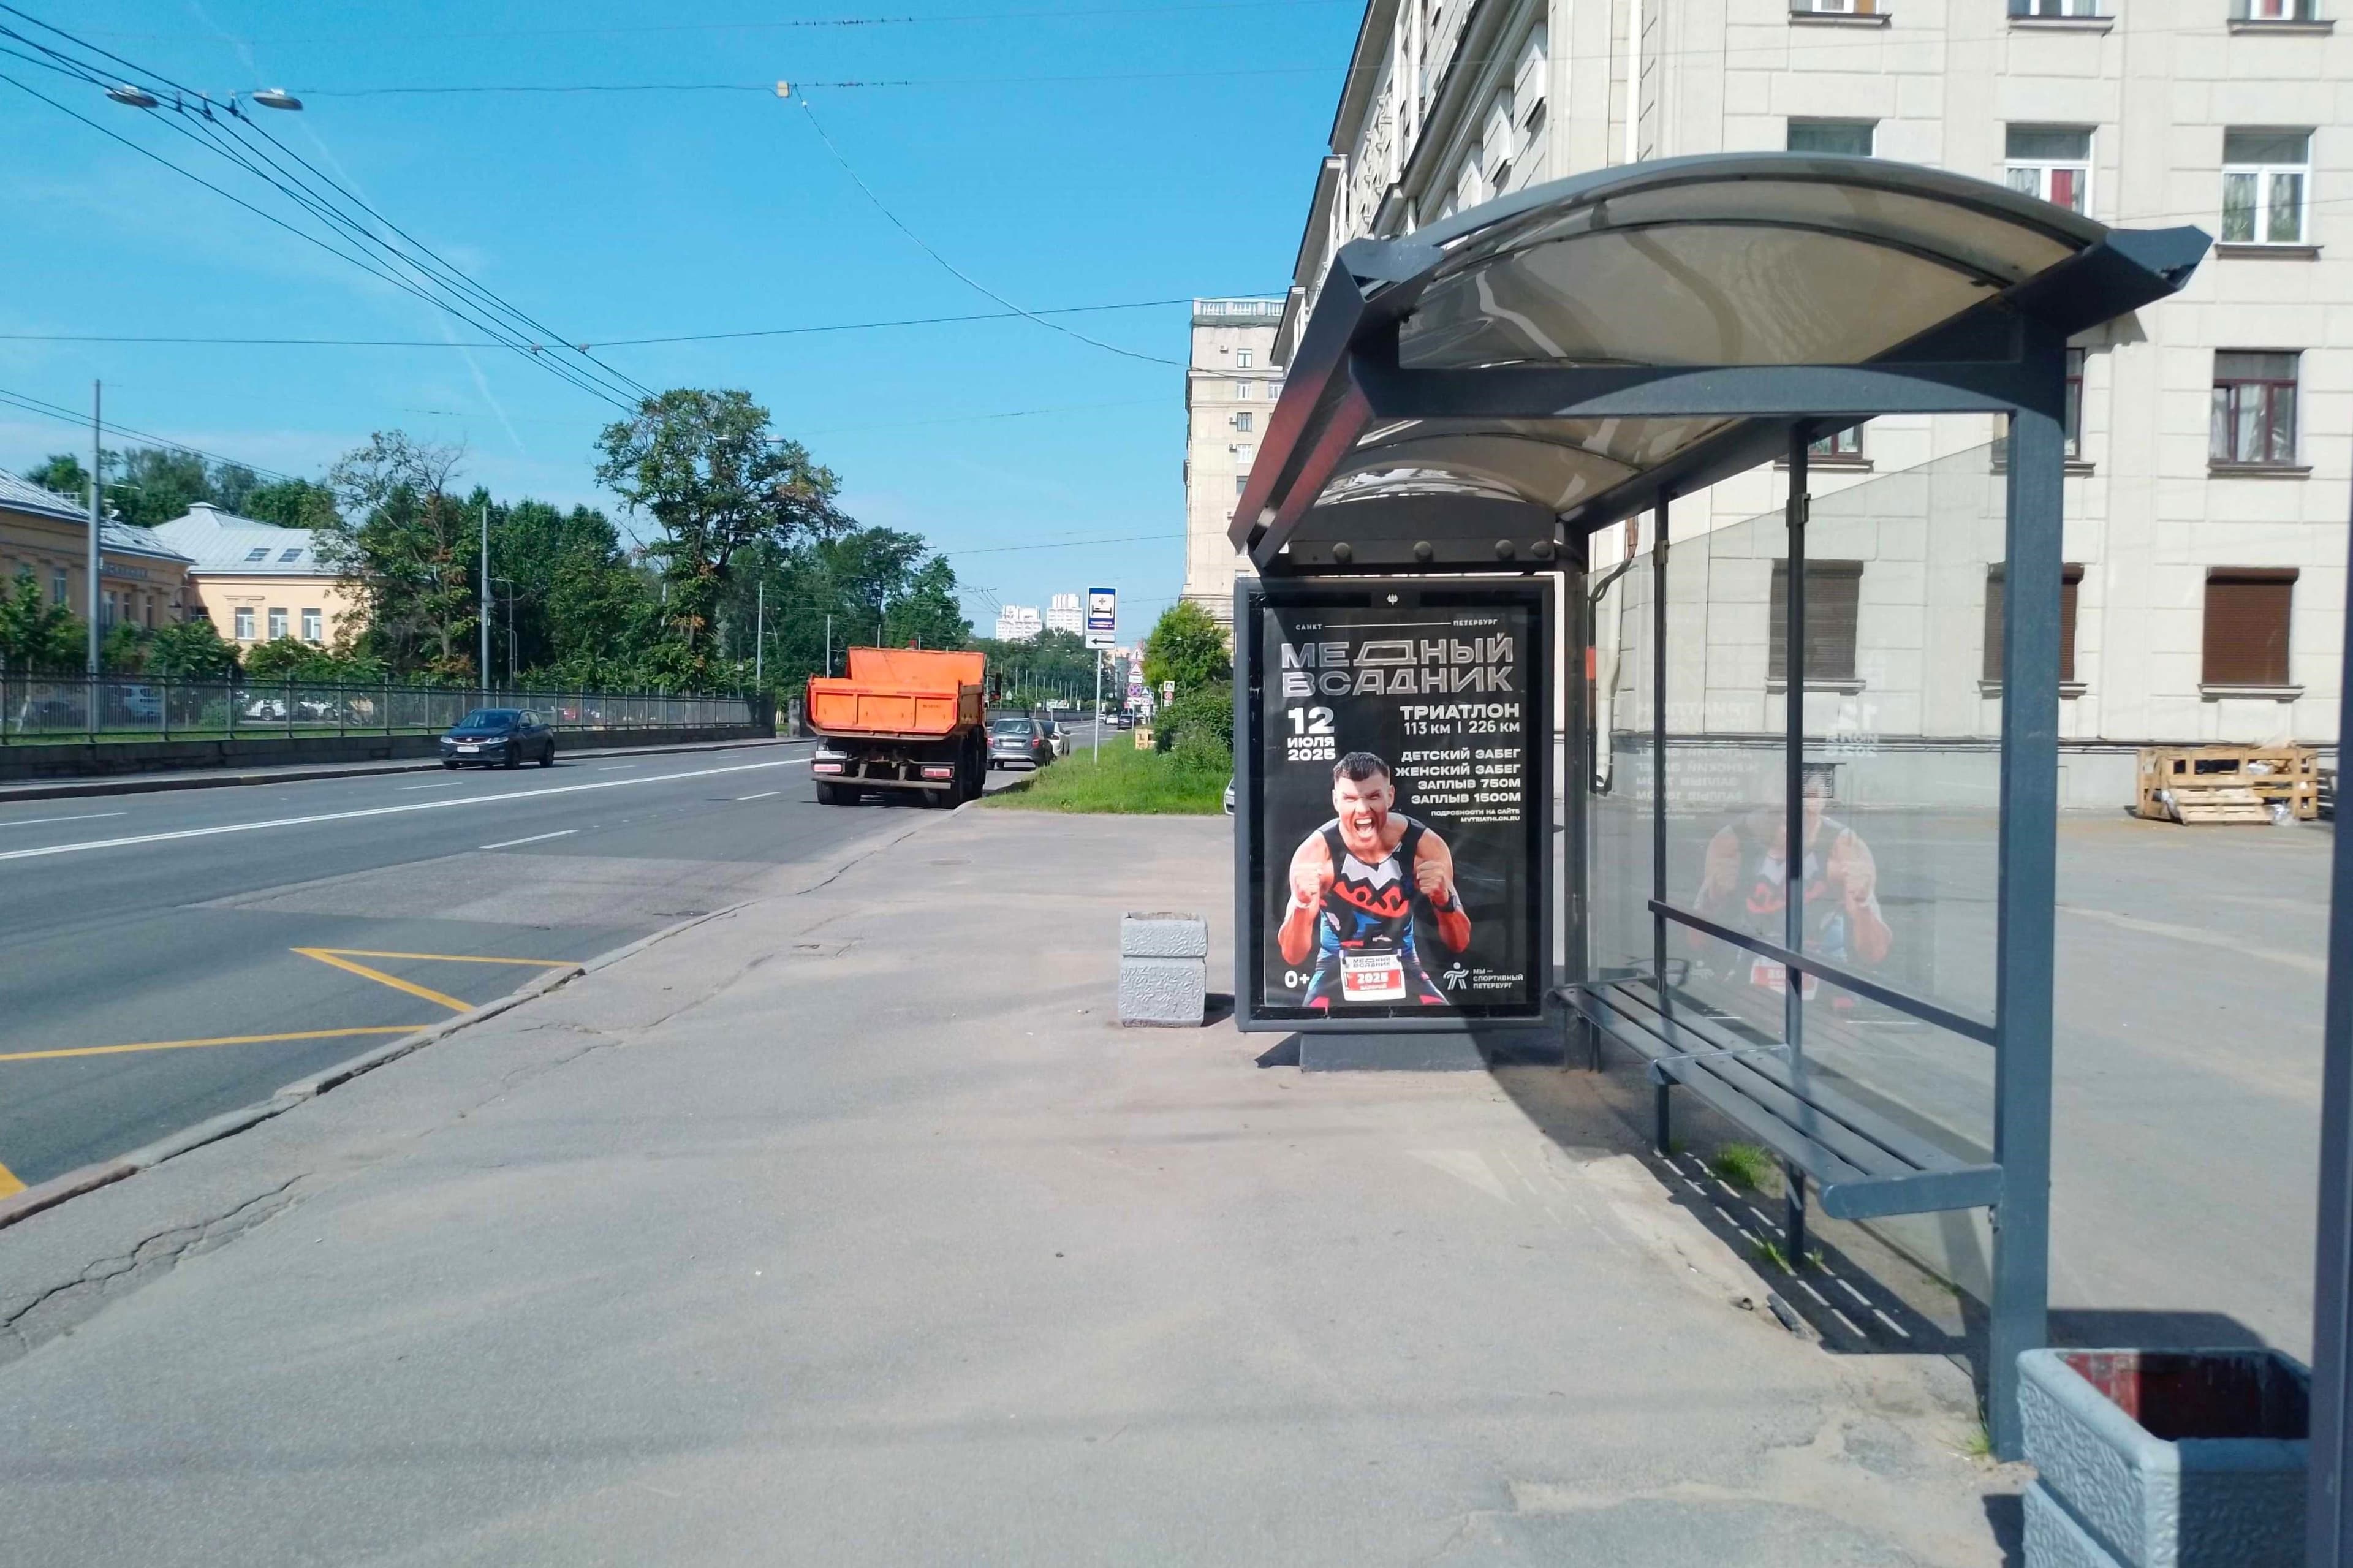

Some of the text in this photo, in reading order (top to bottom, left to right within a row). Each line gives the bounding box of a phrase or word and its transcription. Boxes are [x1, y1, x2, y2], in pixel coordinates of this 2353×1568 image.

[1281, 632, 1514, 668] МЕДНЫЙ
[1282, 666, 1514, 697] ВСАДНИК
[1400, 703, 1520, 721] ТРИАТЛОН
[1288, 706, 1335, 734] 12
[1404, 722, 1427, 735] 113
[1468, 720, 1496, 733] 226
[1287, 737, 1335, 748] ИЮЛЯ
[1287, 748, 1336, 761] 2025
[1401, 747, 1521, 762] ДЕТСКИЙ ЗАБЕГ
[1395, 762, 1521, 777] ЖЕНСКИЙ ЗАБЕГ
[1417, 778, 1521, 790] ЗАПЛЫВ 750М
[1411, 792, 1521, 805] ЗАПЛЫВ 1500М
[1284, 970, 1310, 988] 0+
